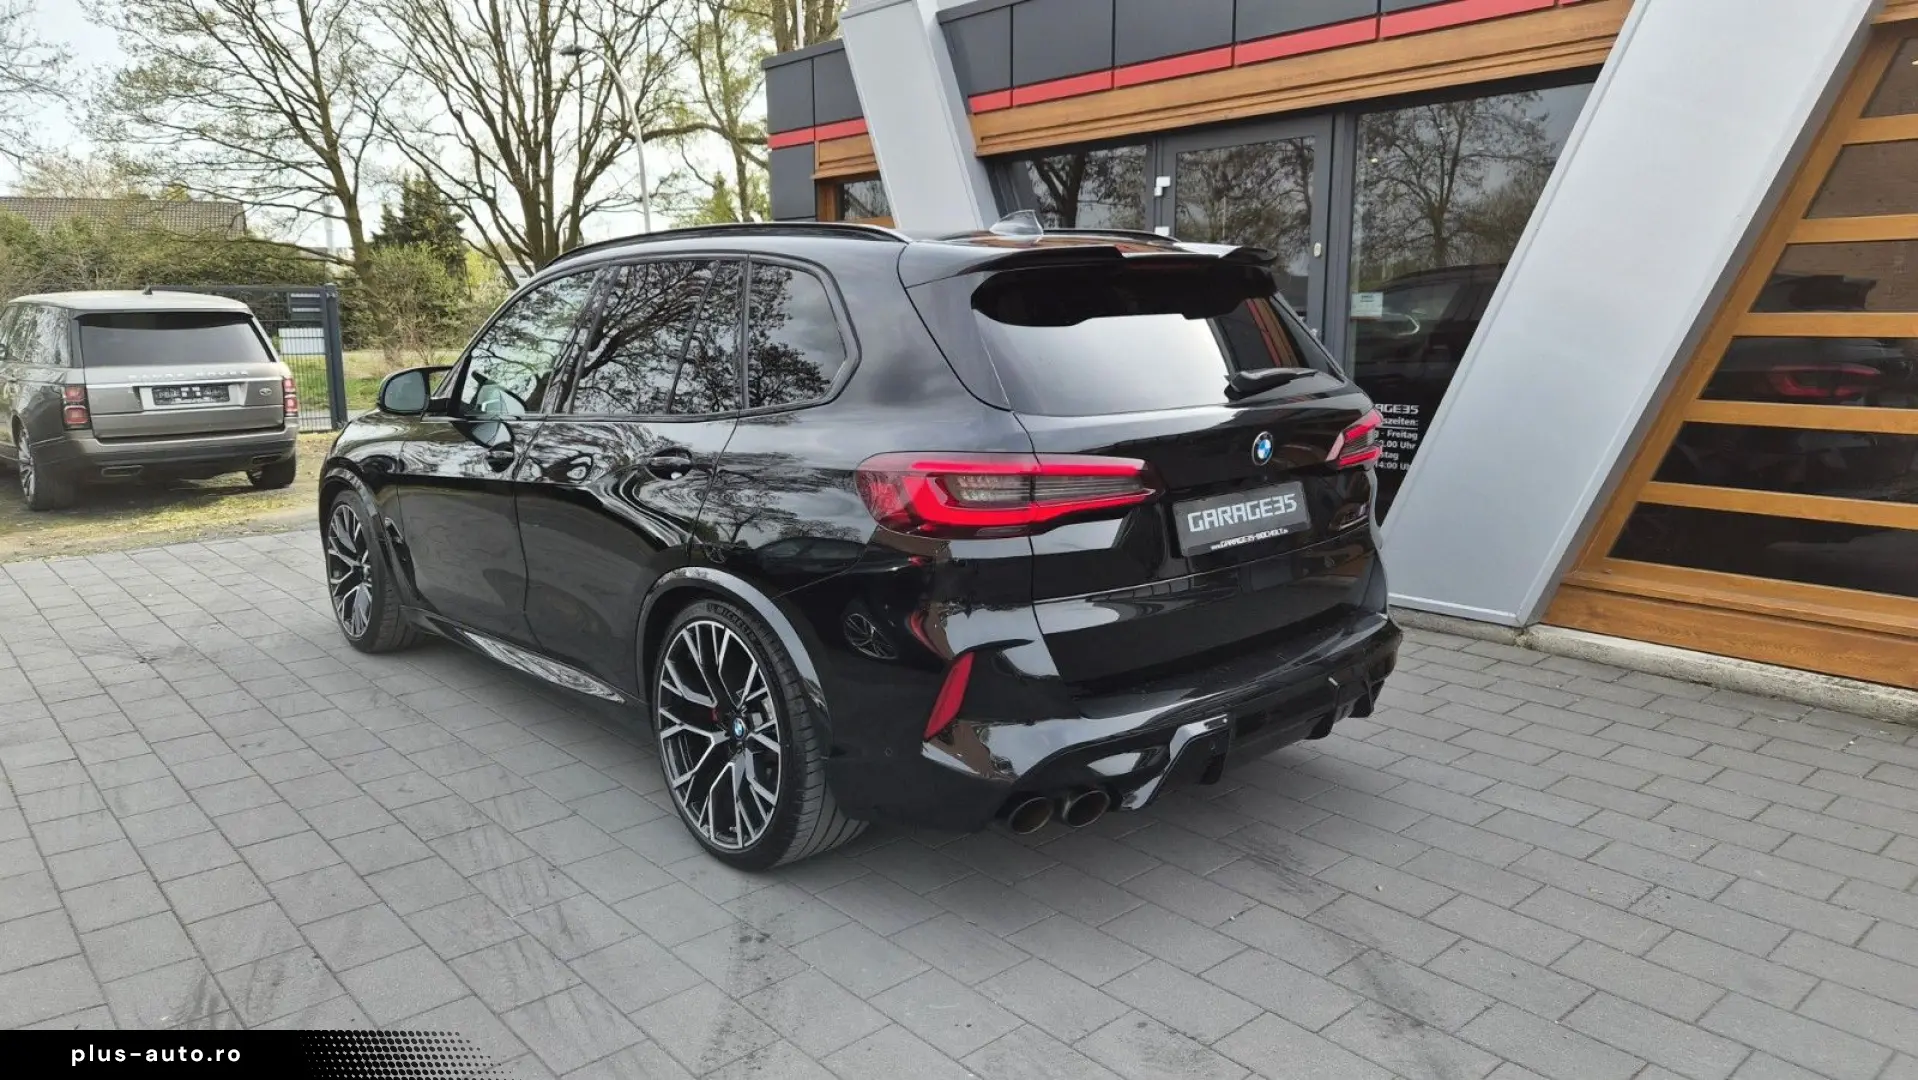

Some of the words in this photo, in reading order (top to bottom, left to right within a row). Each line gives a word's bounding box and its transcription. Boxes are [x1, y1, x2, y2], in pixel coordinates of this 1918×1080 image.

[1387, 429, 1418, 441] Freitag
[1400, 441, 1416, 449] Uhr
[1187, 494, 1297, 532] GARAGE35
